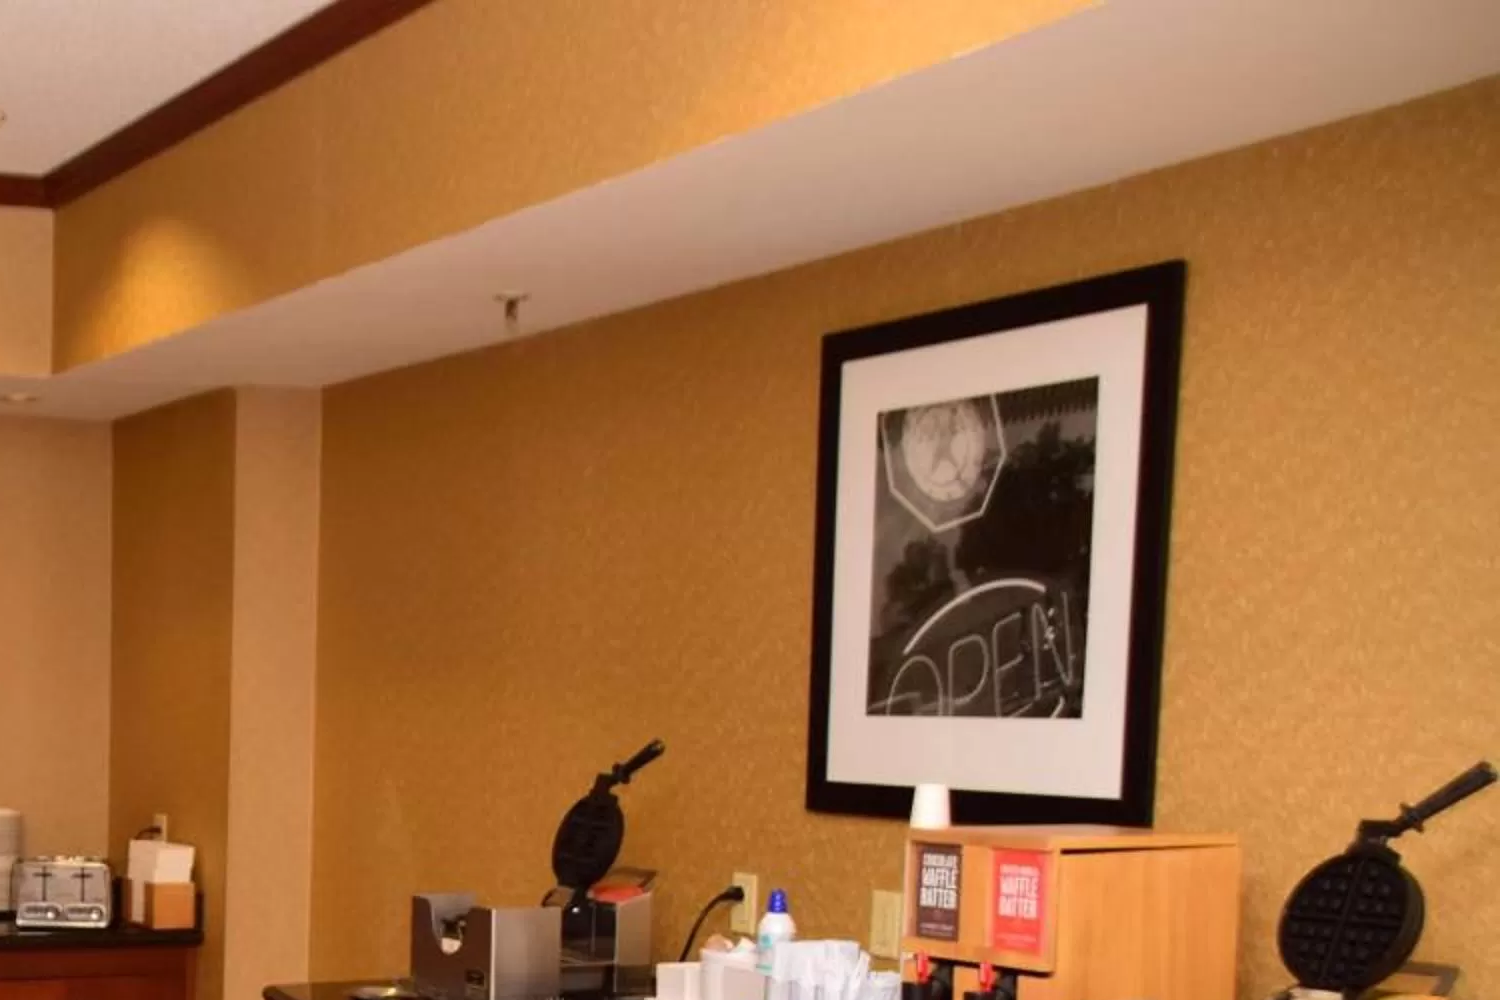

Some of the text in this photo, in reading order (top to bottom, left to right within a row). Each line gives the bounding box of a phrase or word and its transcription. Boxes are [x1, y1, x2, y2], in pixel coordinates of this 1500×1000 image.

[886, 591, 1075, 717] OPEN
[921, 867, 959, 889] WAFFLE
[1000, 875, 1040, 897] WAFFLE
[919, 887, 958, 910] BATTER
[998, 895, 1038, 919] BATTER
